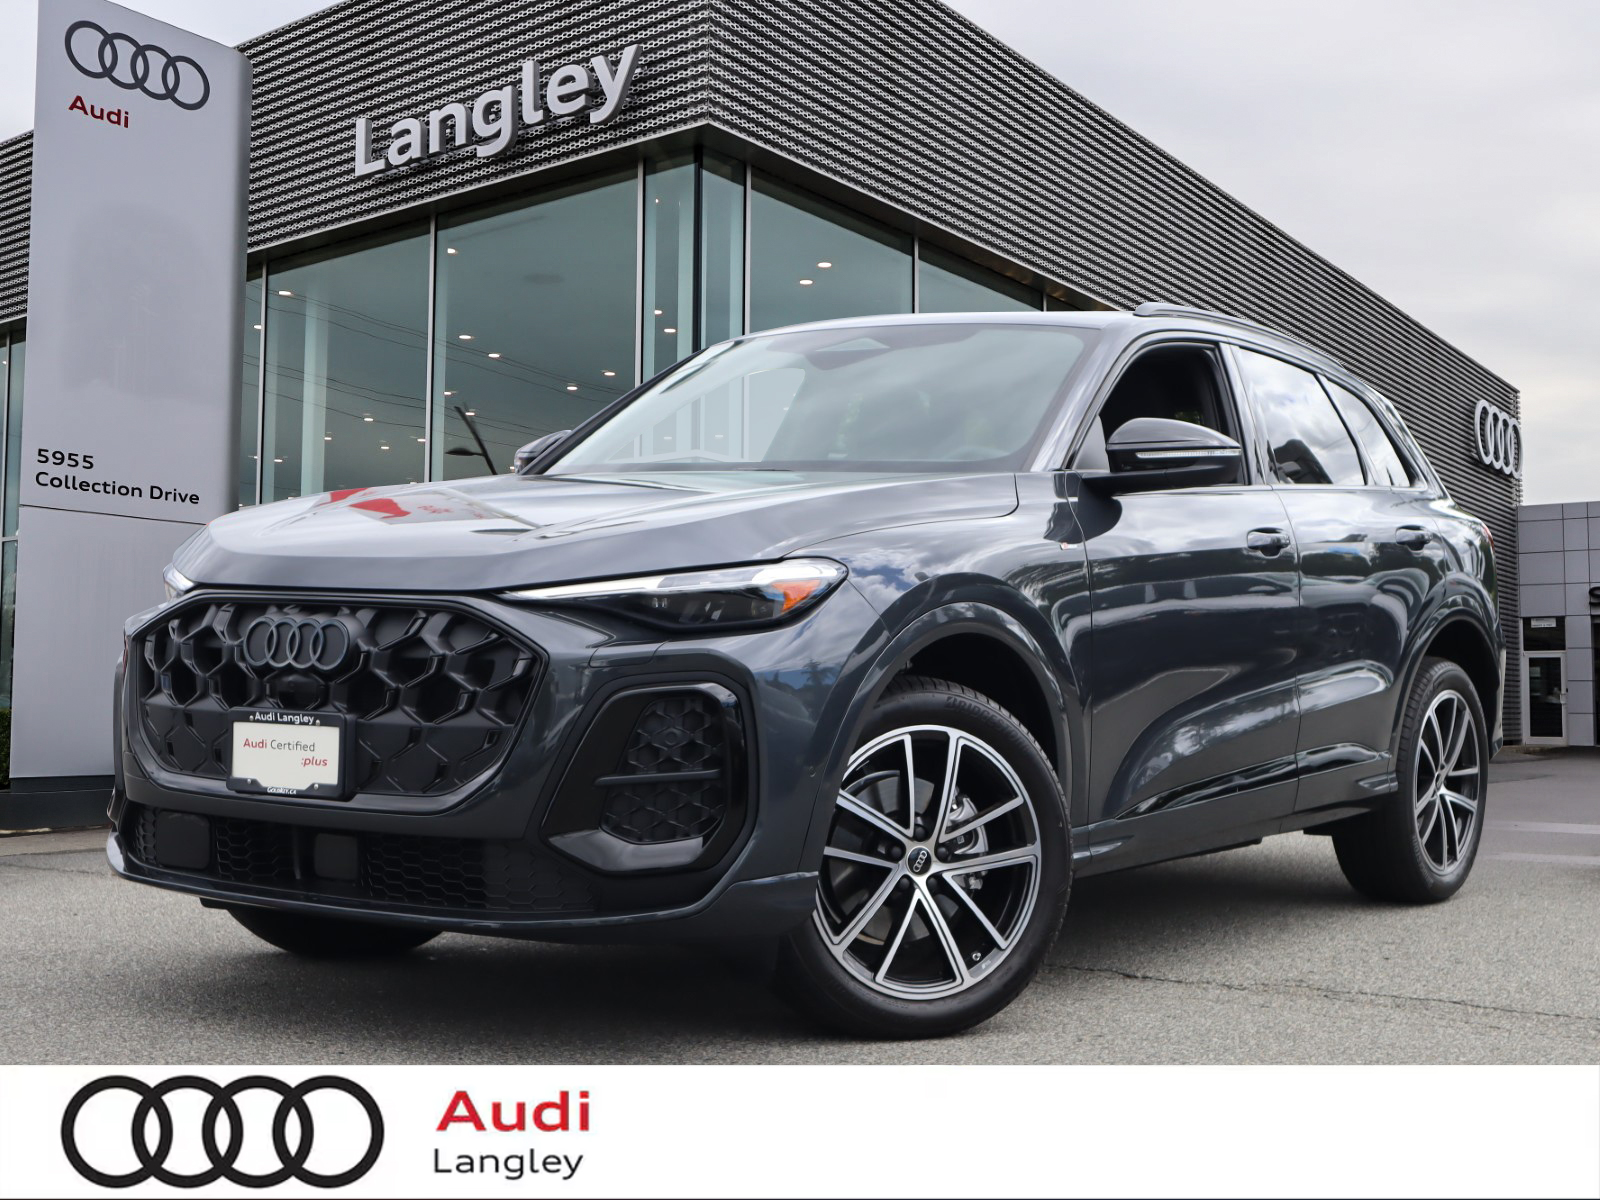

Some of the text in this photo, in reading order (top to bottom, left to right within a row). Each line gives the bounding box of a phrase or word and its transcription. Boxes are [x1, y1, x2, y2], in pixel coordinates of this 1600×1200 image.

[68, 95, 129, 129] Audi
[354, 44, 643, 177] Langley
[37, 448, 94, 469] 5955
[35, 471, 200, 504] Collection Drive
[255, 712, 314, 725] Audi Langley
[243, 738, 315, 752] Audi Certified
